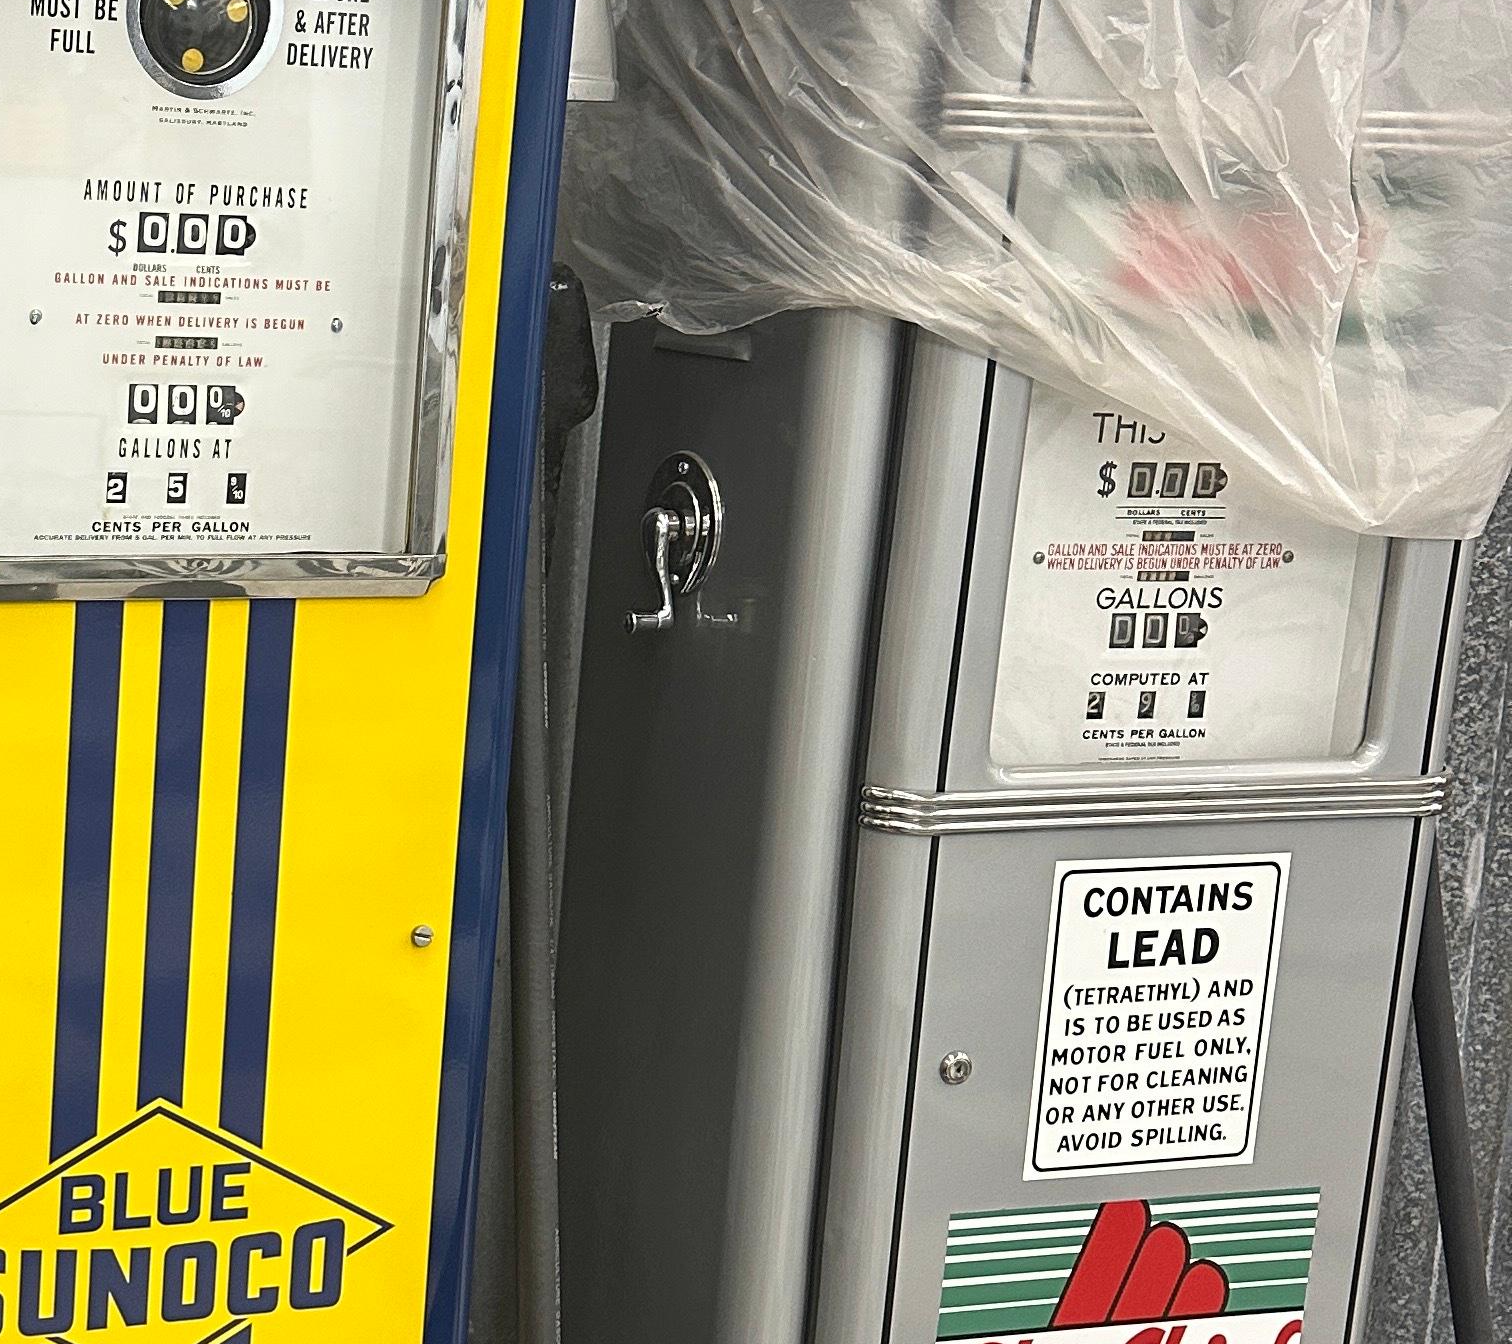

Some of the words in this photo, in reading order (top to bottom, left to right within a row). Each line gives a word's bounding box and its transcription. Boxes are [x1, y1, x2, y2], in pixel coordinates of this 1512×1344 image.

[295, 11, 307, 33] &
[314, 11, 369, 37] AFTER
[50, 28, 96, 55] FULL
[286, 43, 374, 70] DELIVERY
[84, 179, 162, 203] AMOUNT
[176, 183, 196, 205] OF
[210, 184, 309, 209] PURCHASE
[54, 272, 105, 285] GALLON
[112, 274, 137, 287] AND
[145, 275, 176, 287] SALE
[184, 276, 268, 289] INDICATIONS
[276, 279, 309, 291] MUST
[316, 280, 331, 292] BE
[75, 314, 90, 325] AT
[97, 314, 129, 326] ZERO
[136, 315, 172, 327] WHEN
[178, 316, 239, 328] DELIVERY
[246, 318, 257, 329] IS
[264, 318, 306, 330] BEGUN
[102, 353, 146, 365] UNDER
[153, 355, 209, 367] PENALTY
[217, 356, 232, 367] OF
[119, 438, 201, 459] GALLONS
[212, 439, 232, 459] AT
[107, 478, 124, 500] 2
[168, 476, 184, 498] 5
[92, 521, 142, 533] CENTS
[152, 521, 181, 533] PER
[192, 521, 250, 533] GALLON
[1048, 543, 1086, 556] GALLON
[1088, 543, 1108, 556] AND
[1111, 543, 1136, 556] SALE
[1138, 543, 1198, 556] INDICATIONS
[1201, 543, 1226, 556] MUST
[1228, 543, 1240, 555] BE
[1242, 543, 1254, 555] AT
[1256, 543, 1282, 555] ZERO
[1048, 557, 1075, 570] WHEN
[1078, 557, 1123, 570] DELIVERY
[1125, 557, 1134, 570] IS
[1137, 557, 1167, 570] BEGUN
[1170, 557, 1200, 569] UNDER
[1203, 557, 1244, 569] PENALTY
[1246, 557, 1258, 569] OF
[1097, 587, 1223, 610] GALLONS
[1090, 673, 1181, 686] COMPUTED
[1188, 672, 1210, 685] AT
[1088, 692, 1100, 713] 2
[1141, 692, 1152, 713] 9
[1082, 730, 1124, 739] CENTS
[1130, 729, 1154, 738] PER
[1159, 729, 1206, 738] GALLON
[1083, 881, 1253, 918] CONTAINS
[1107, 927, 1219, 970] LEAD
[1064, 977, 1200, 1009] (TETRAETHYL)
[1208, 979, 1253, 999] AND
[1065, 1017, 1085, 1036] IS
[1095, 1016, 1120, 1035] TO
[1127, 1013, 1151, 1033] BE
[1158, 1010, 1212, 1031] USED
[1218, 1008, 1245, 1026] AS
[1051, 1044, 1126, 1067] MOTOR
[1135, 1040, 1184, 1061] FUEL
[1049, 1076, 1091, 1096] NOT
[1097, 1072, 1139, 1093] FOR
[1146, 1065, 1248, 1089] CLEANING
[1045, 1106, 1074, 1125] OR
[1082, 1102, 1125, 1123] ANY
[1131, 1097, 1194, 1119] OTHER
[1202, 1094, 1244, 1113] USE.
[1057, 1131, 1122, 1153] AVOID
[1131, 1123, 1227, 1147] SPILLING.
[59, 1162, 252, 1235] BLUE
